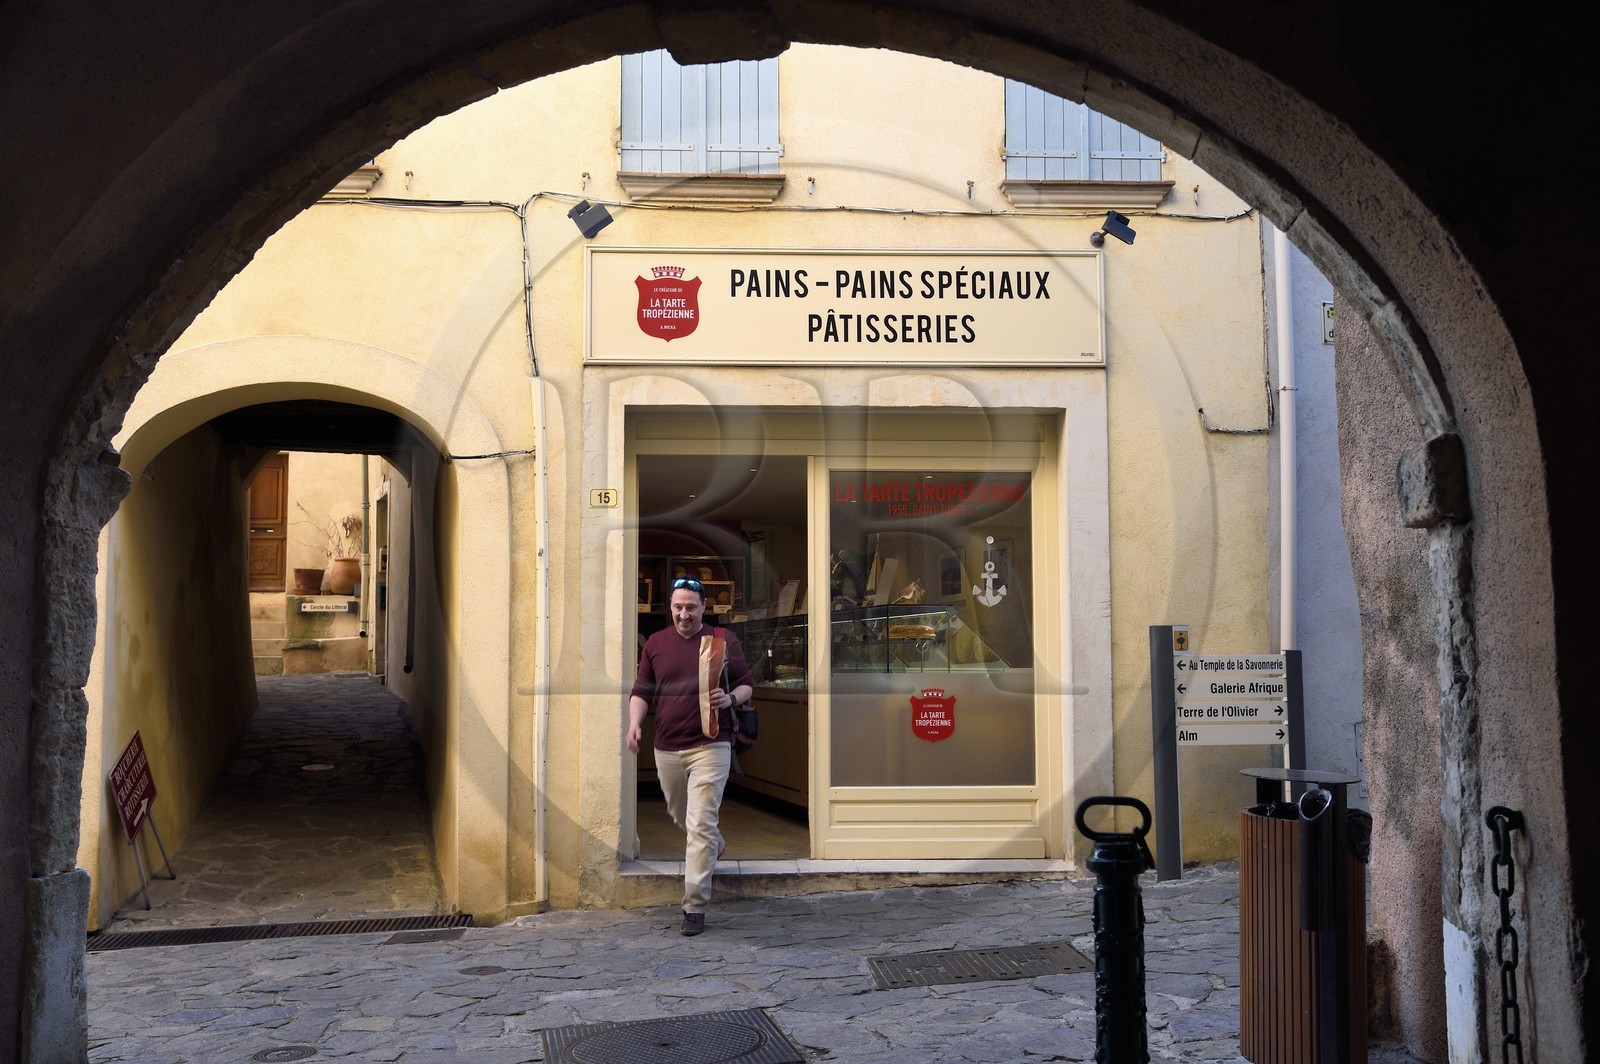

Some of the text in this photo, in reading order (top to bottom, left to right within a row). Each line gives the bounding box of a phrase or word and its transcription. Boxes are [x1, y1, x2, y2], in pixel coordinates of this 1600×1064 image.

[730, 269, 809, 298] PAINS
[835, 270, 913, 299] PAINS
[920, 266, 1051, 299] SPÉCIAUX
[650, 298, 686, 308] LA TARTE
[642, 307, 695, 319] TROPÉZIENNE
[808, 308, 976, 343] PÂTISSERIES
[597, 492, 610, 504] 15
[834, 483, 856, 502] LA
[861, 483, 910, 502] TARTE
[912, 504, 938, 516] SAINT
[1189, 659, 1283, 672] Au Temple de la Savonnerie
[1210, 683, 1283, 695] Galerie Afrique
[920, 711, 945, 719] LA TARTE
[1177, 706, 1259, 717] Terre de l'Olivier
[1178, 730, 1198, 741] Alm
[114, 740, 140, 785] BOUCHERIE
[117, 750, 147, 806] CHARCUTERIE
